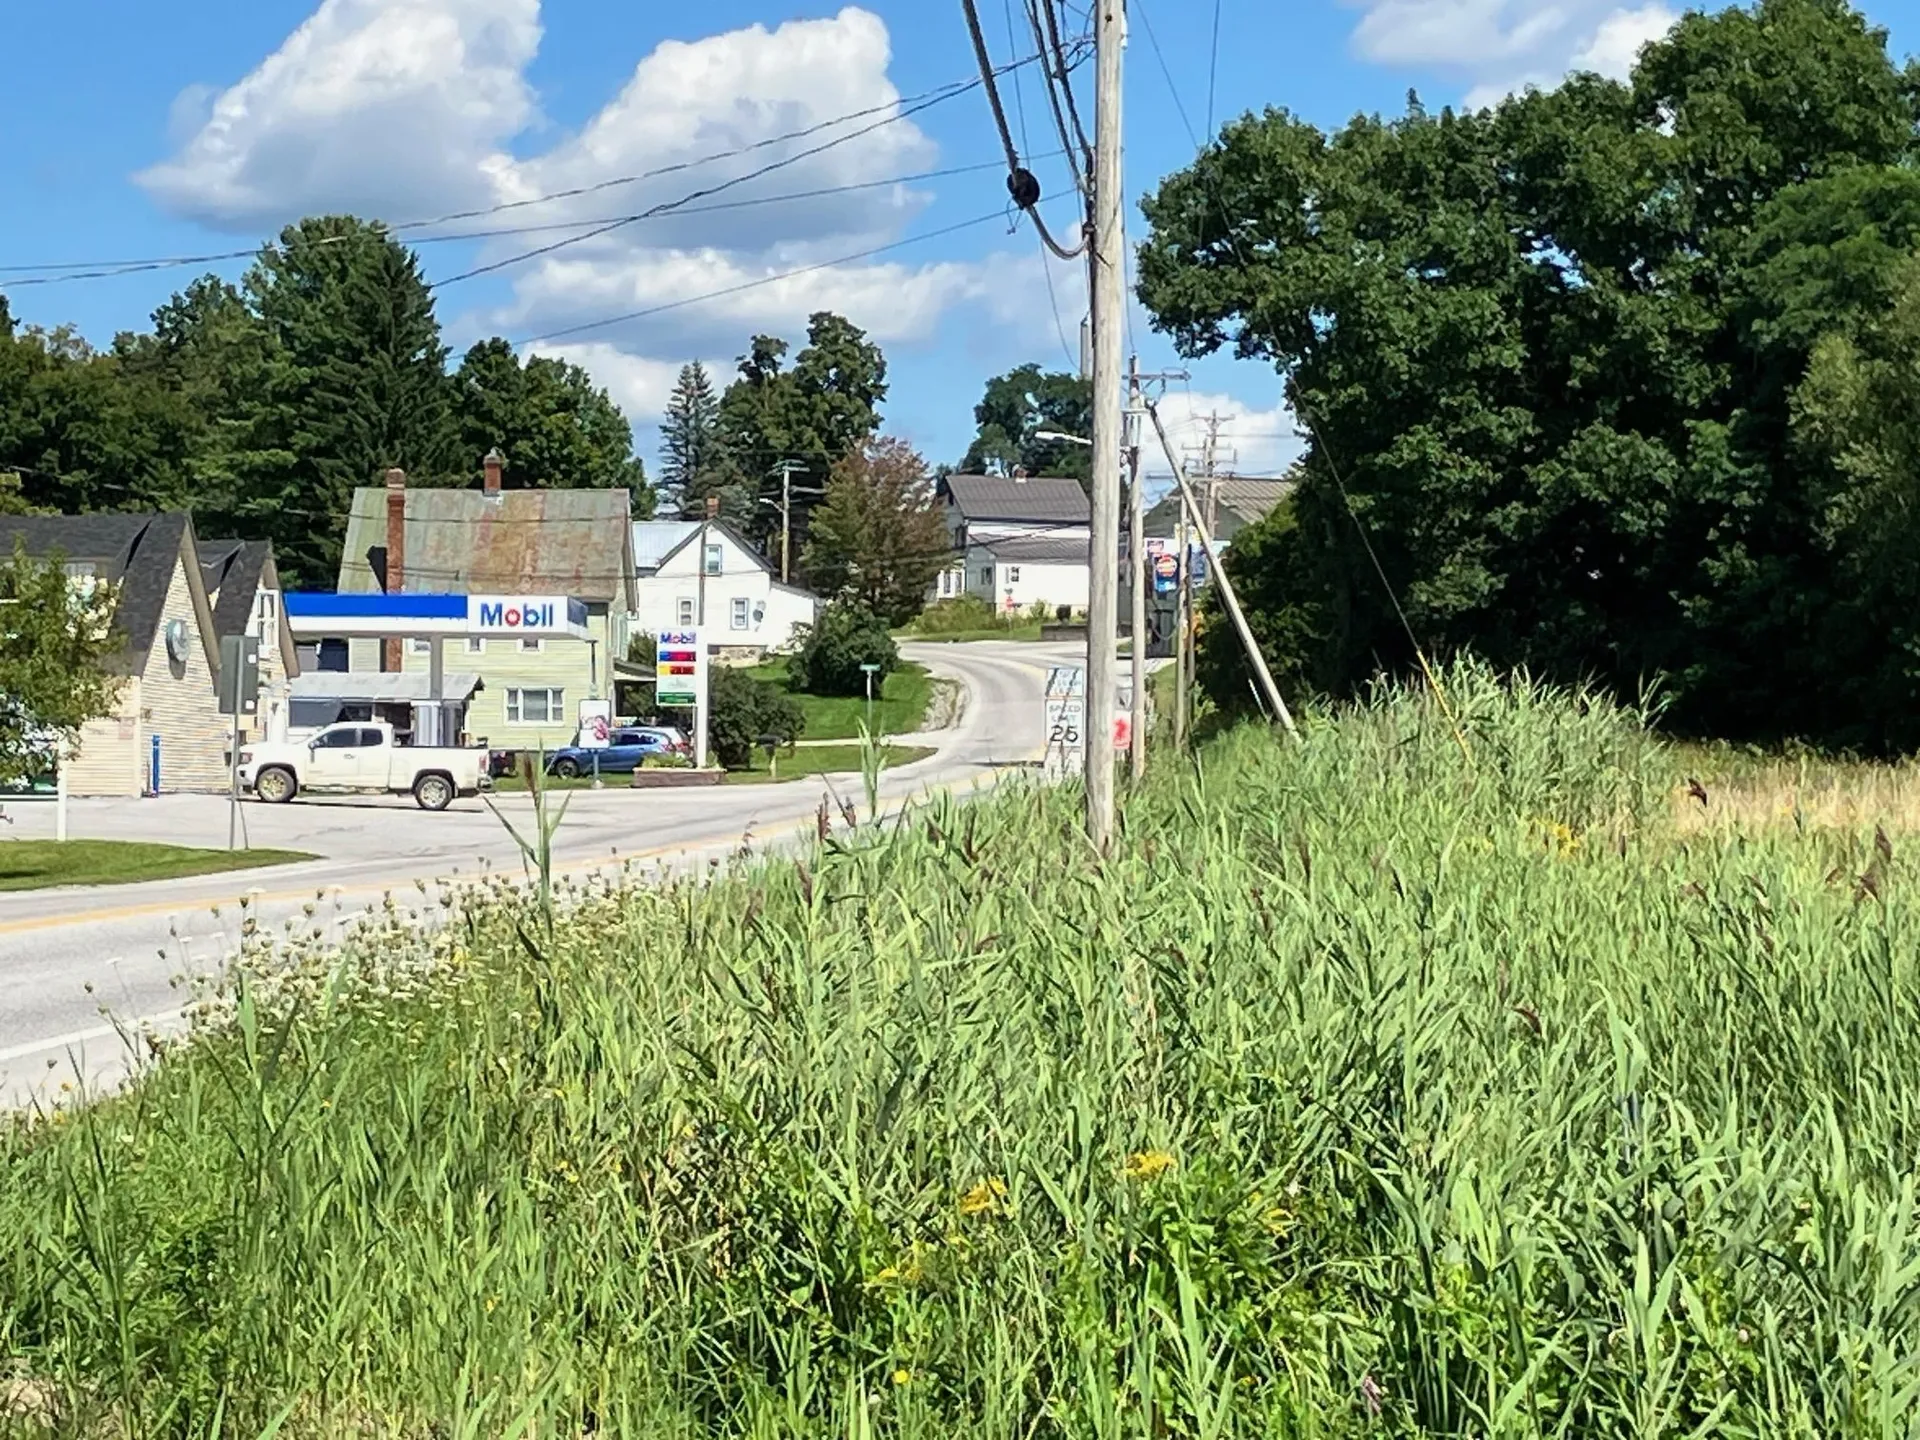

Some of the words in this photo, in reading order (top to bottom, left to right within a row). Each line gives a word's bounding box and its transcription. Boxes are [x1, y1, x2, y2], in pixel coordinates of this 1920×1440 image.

[481, 602, 553, 627] Mobil
[660, 632, 697, 644] Mobil
[1050, 725, 1078, 743] 25
